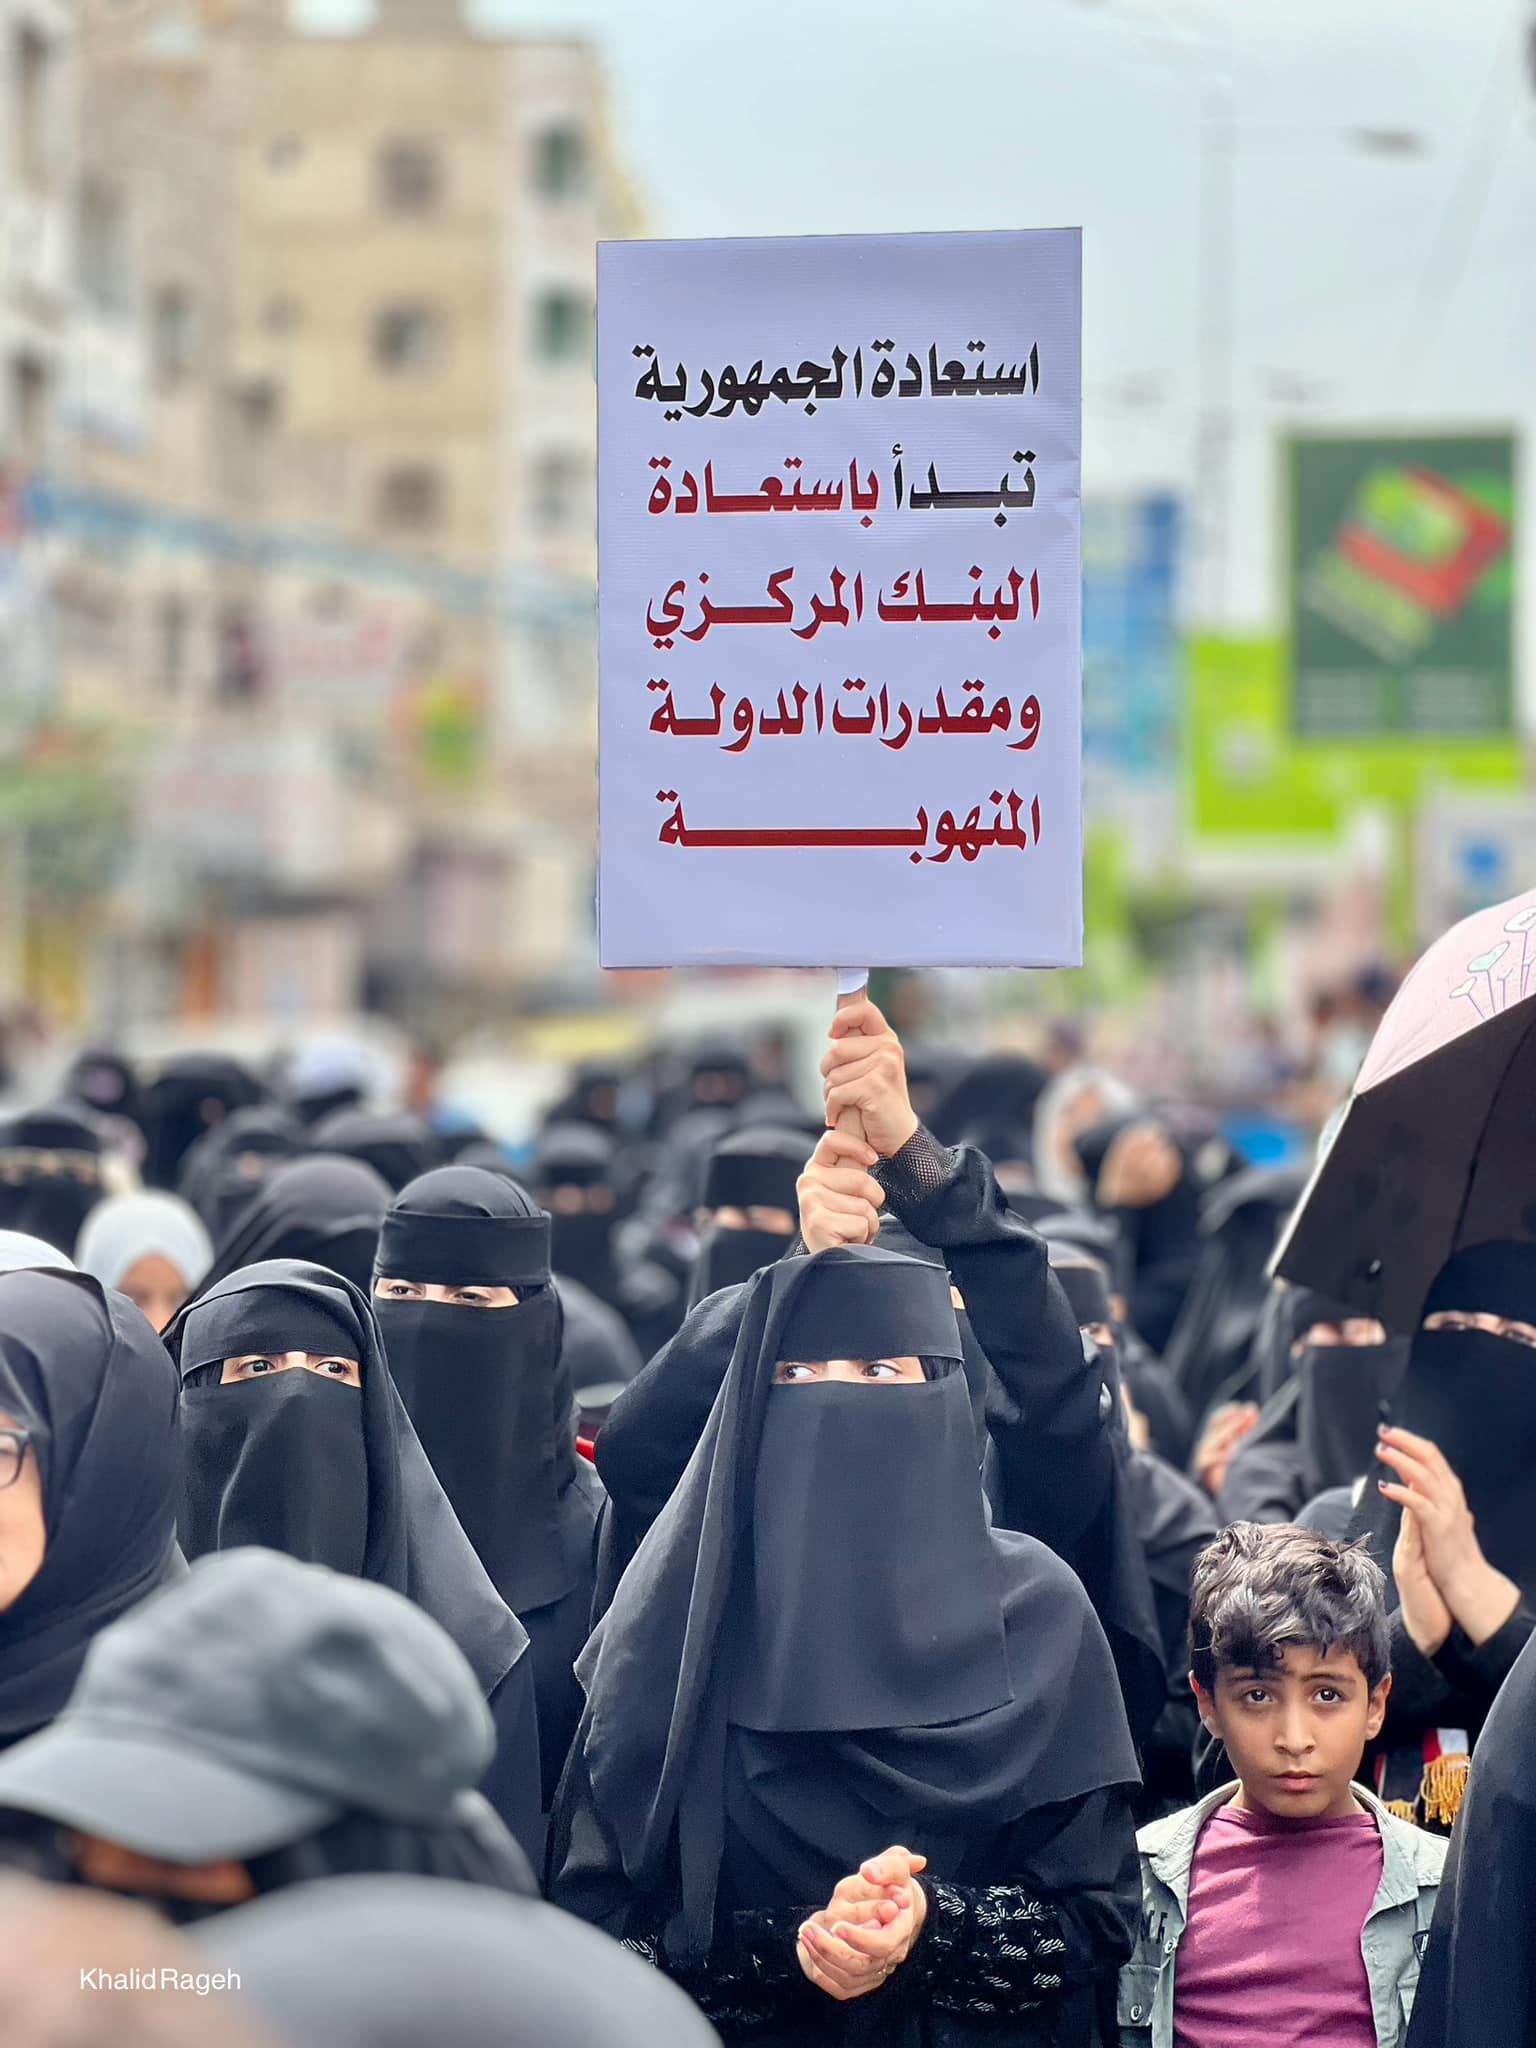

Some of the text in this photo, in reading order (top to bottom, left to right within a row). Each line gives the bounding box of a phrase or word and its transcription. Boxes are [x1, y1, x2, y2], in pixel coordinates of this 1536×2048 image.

[631, 338, 1040, 422] استعادة الجمهورية
[647, 443, 1037, 529] تبدأ باستعادة
[646, 564, 1040, 650] البنك المركزي
[646, 677, 1041, 753] ومقدرات الدولة
[655, 788, 1041, 865] المنهوبة
